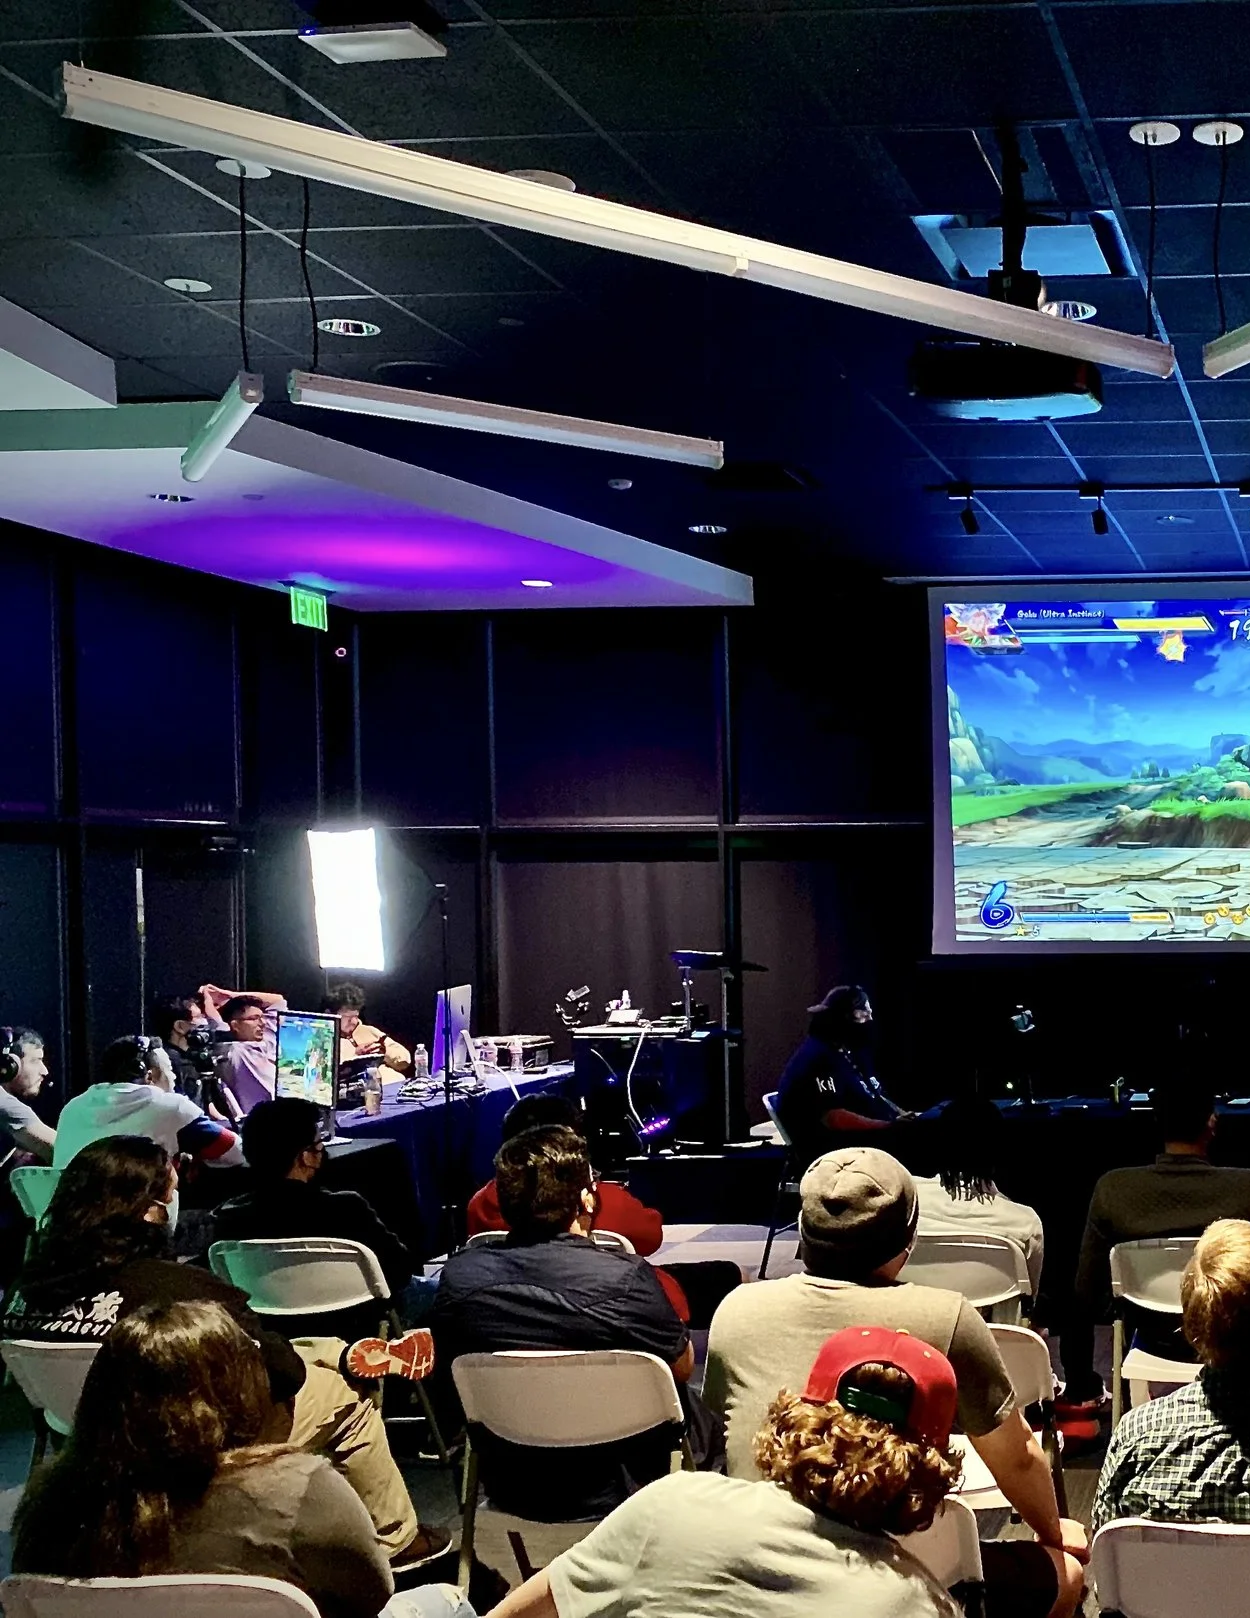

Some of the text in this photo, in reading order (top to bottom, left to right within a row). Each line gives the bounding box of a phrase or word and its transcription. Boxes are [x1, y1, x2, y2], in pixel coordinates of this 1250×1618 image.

[296, 592, 324, 629] EXIT
[1017, 609, 1037, 618] Goku
[980, 880, 1014, 928] 6
